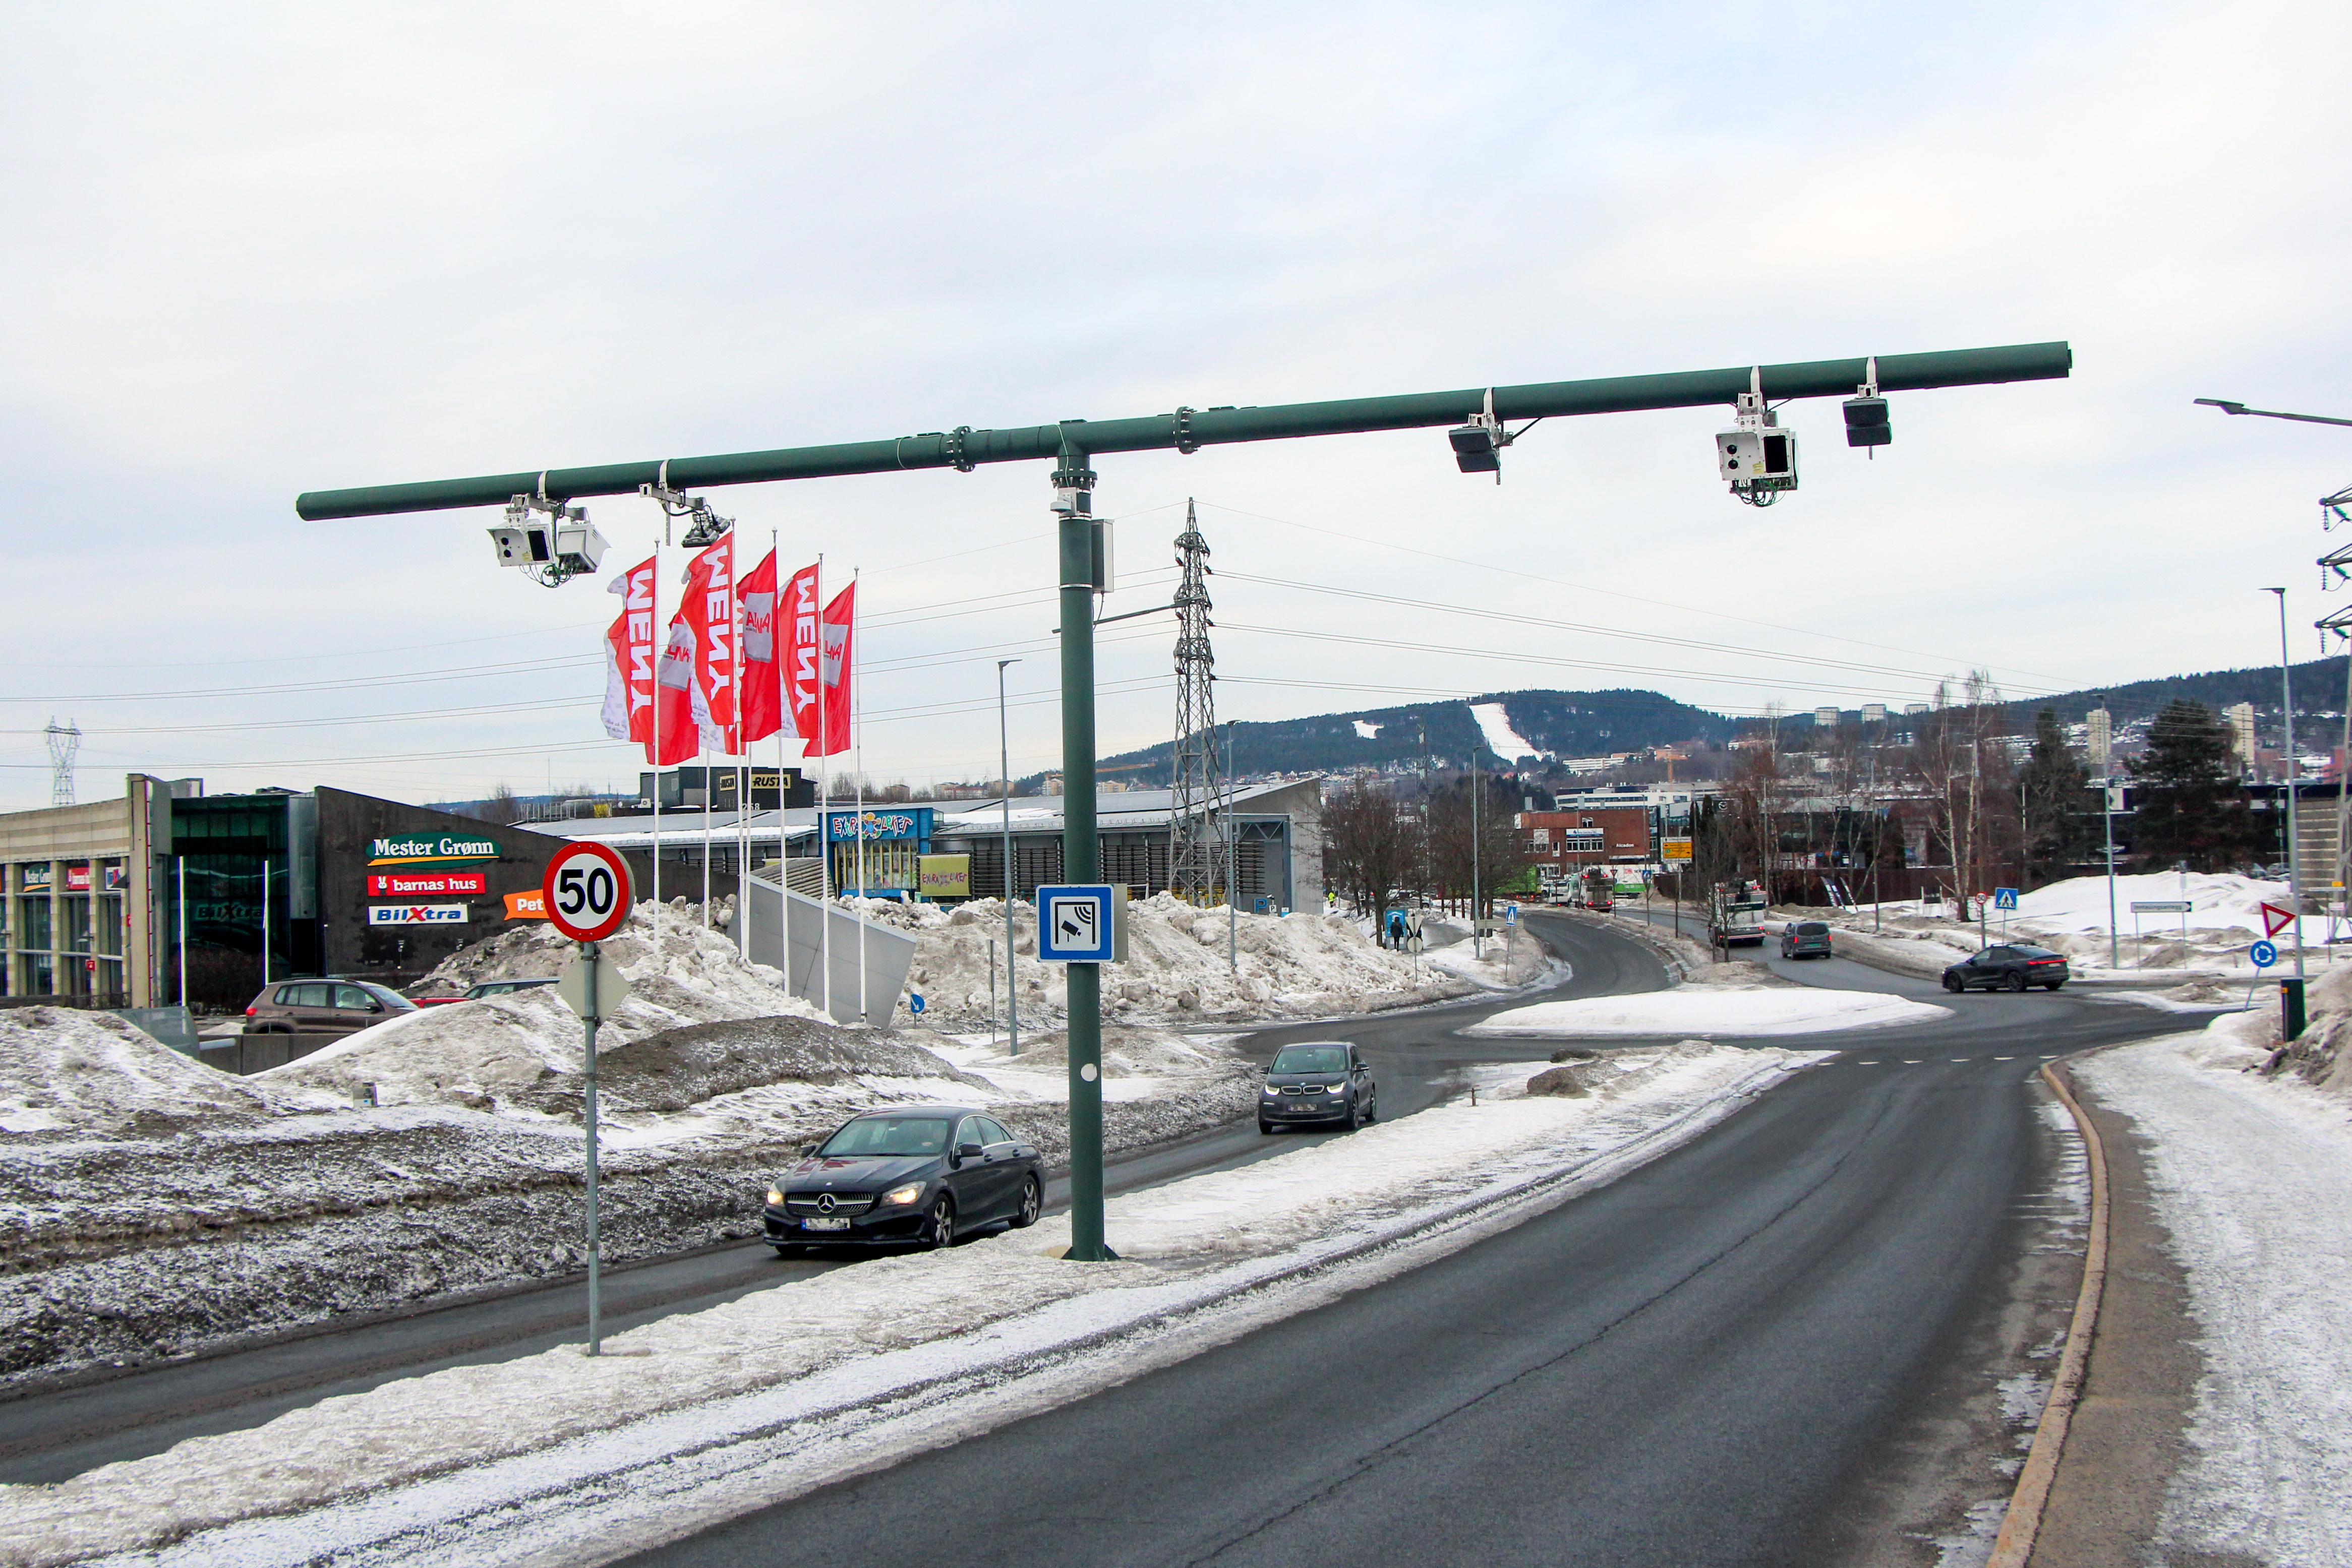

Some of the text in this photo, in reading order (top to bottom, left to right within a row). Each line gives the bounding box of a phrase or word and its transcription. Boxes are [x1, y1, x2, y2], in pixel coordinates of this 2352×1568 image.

[665, 644, 689, 662] LNA
[819, 639, 843, 661] LNA
[753, 776, 788, 787] RUSTA
[373, 838, 494, 856] Mester Grønn
[392, 878, 477, 892] barnas hus
[559, 867, 613, 915] 50
[376, 906, 461, 923] BilXtra
